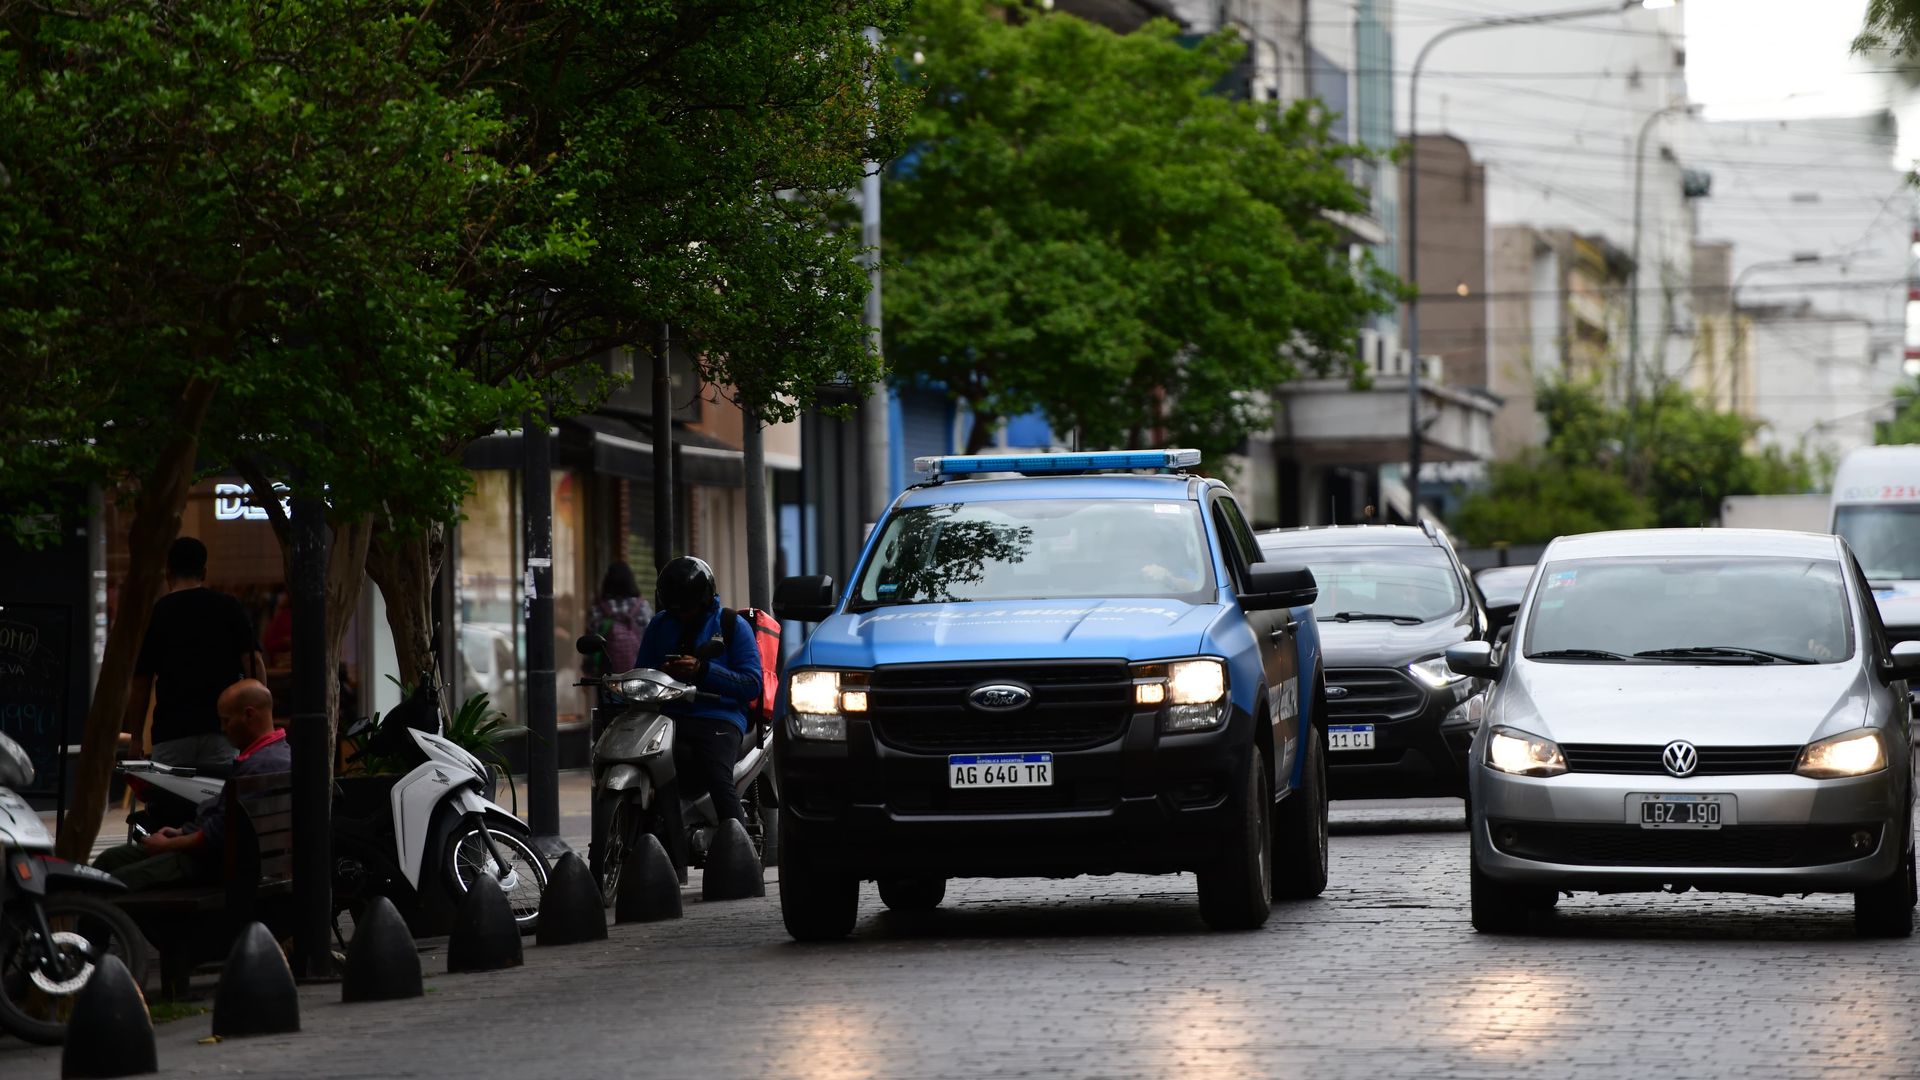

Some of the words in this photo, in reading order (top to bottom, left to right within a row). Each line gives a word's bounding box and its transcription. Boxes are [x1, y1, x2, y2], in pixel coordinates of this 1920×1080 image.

[983, 690, 1017, 705] Ford
[1353, 733, 1370, 747] CI
[955, 766, 977, 784] AG
[984, 765, 1018, 784] 640
[1025, 764, 1047, 782] TR
[1643, 803, 1675, 823] LBZ
[1686, 803, 1718, 823] 190
